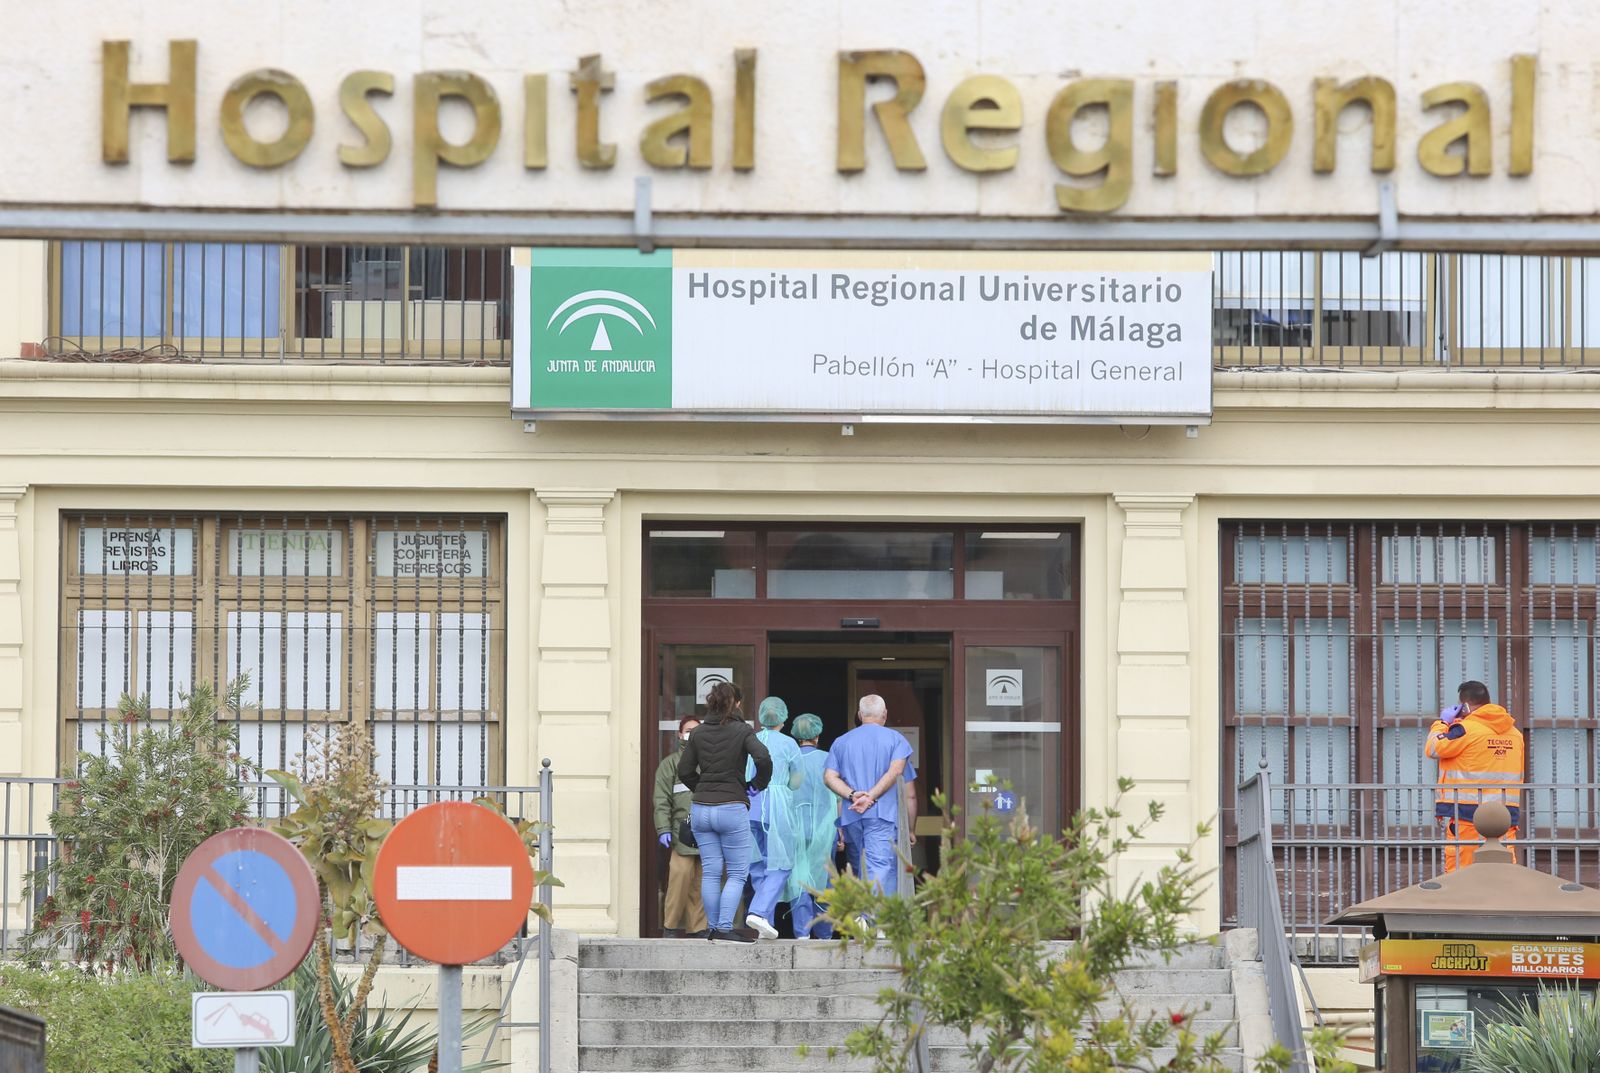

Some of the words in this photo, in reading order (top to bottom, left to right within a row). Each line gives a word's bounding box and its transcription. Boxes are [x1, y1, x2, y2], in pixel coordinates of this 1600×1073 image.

[101, 38, 758, 208] Hospital
[836, 49, 1538, 212] Regional
[688, 272, 818, 305] Hospital
[831, 273, 965, 307] Regional
[979, 275, 1182, 303] Universitario
[1020, 314, 1057, 341] de
[1070, 315, 1182, 348] Málaga
[546, 359, 580, 372] JUNTA
[584, 359, 598, 372] DE
[601, 359, 656, 372] ANDALUCIA
[813, 354, 915, 378] Pabellón
[982, 359, 1081, 384] Hospital
[1091, 359, 1182, 381] General
[109, 531, 161, 542] PRENSA
[243, 533, 328, 550] TENDA
[104, 546, 167, 557] REVISTAS
[395, 549, 472, 560] CONFIERA
[112, 560, 158, 571] LIBROS
[1443, 944, 1475, 957] EURO
[1511, 945, 1540, 953] CADA
[1431, 956, 1490, 971] JACKPOT
[1511, 952, 1585, 965] BOTES
[1511, 965, 1585, 974] MILLONARIOS
